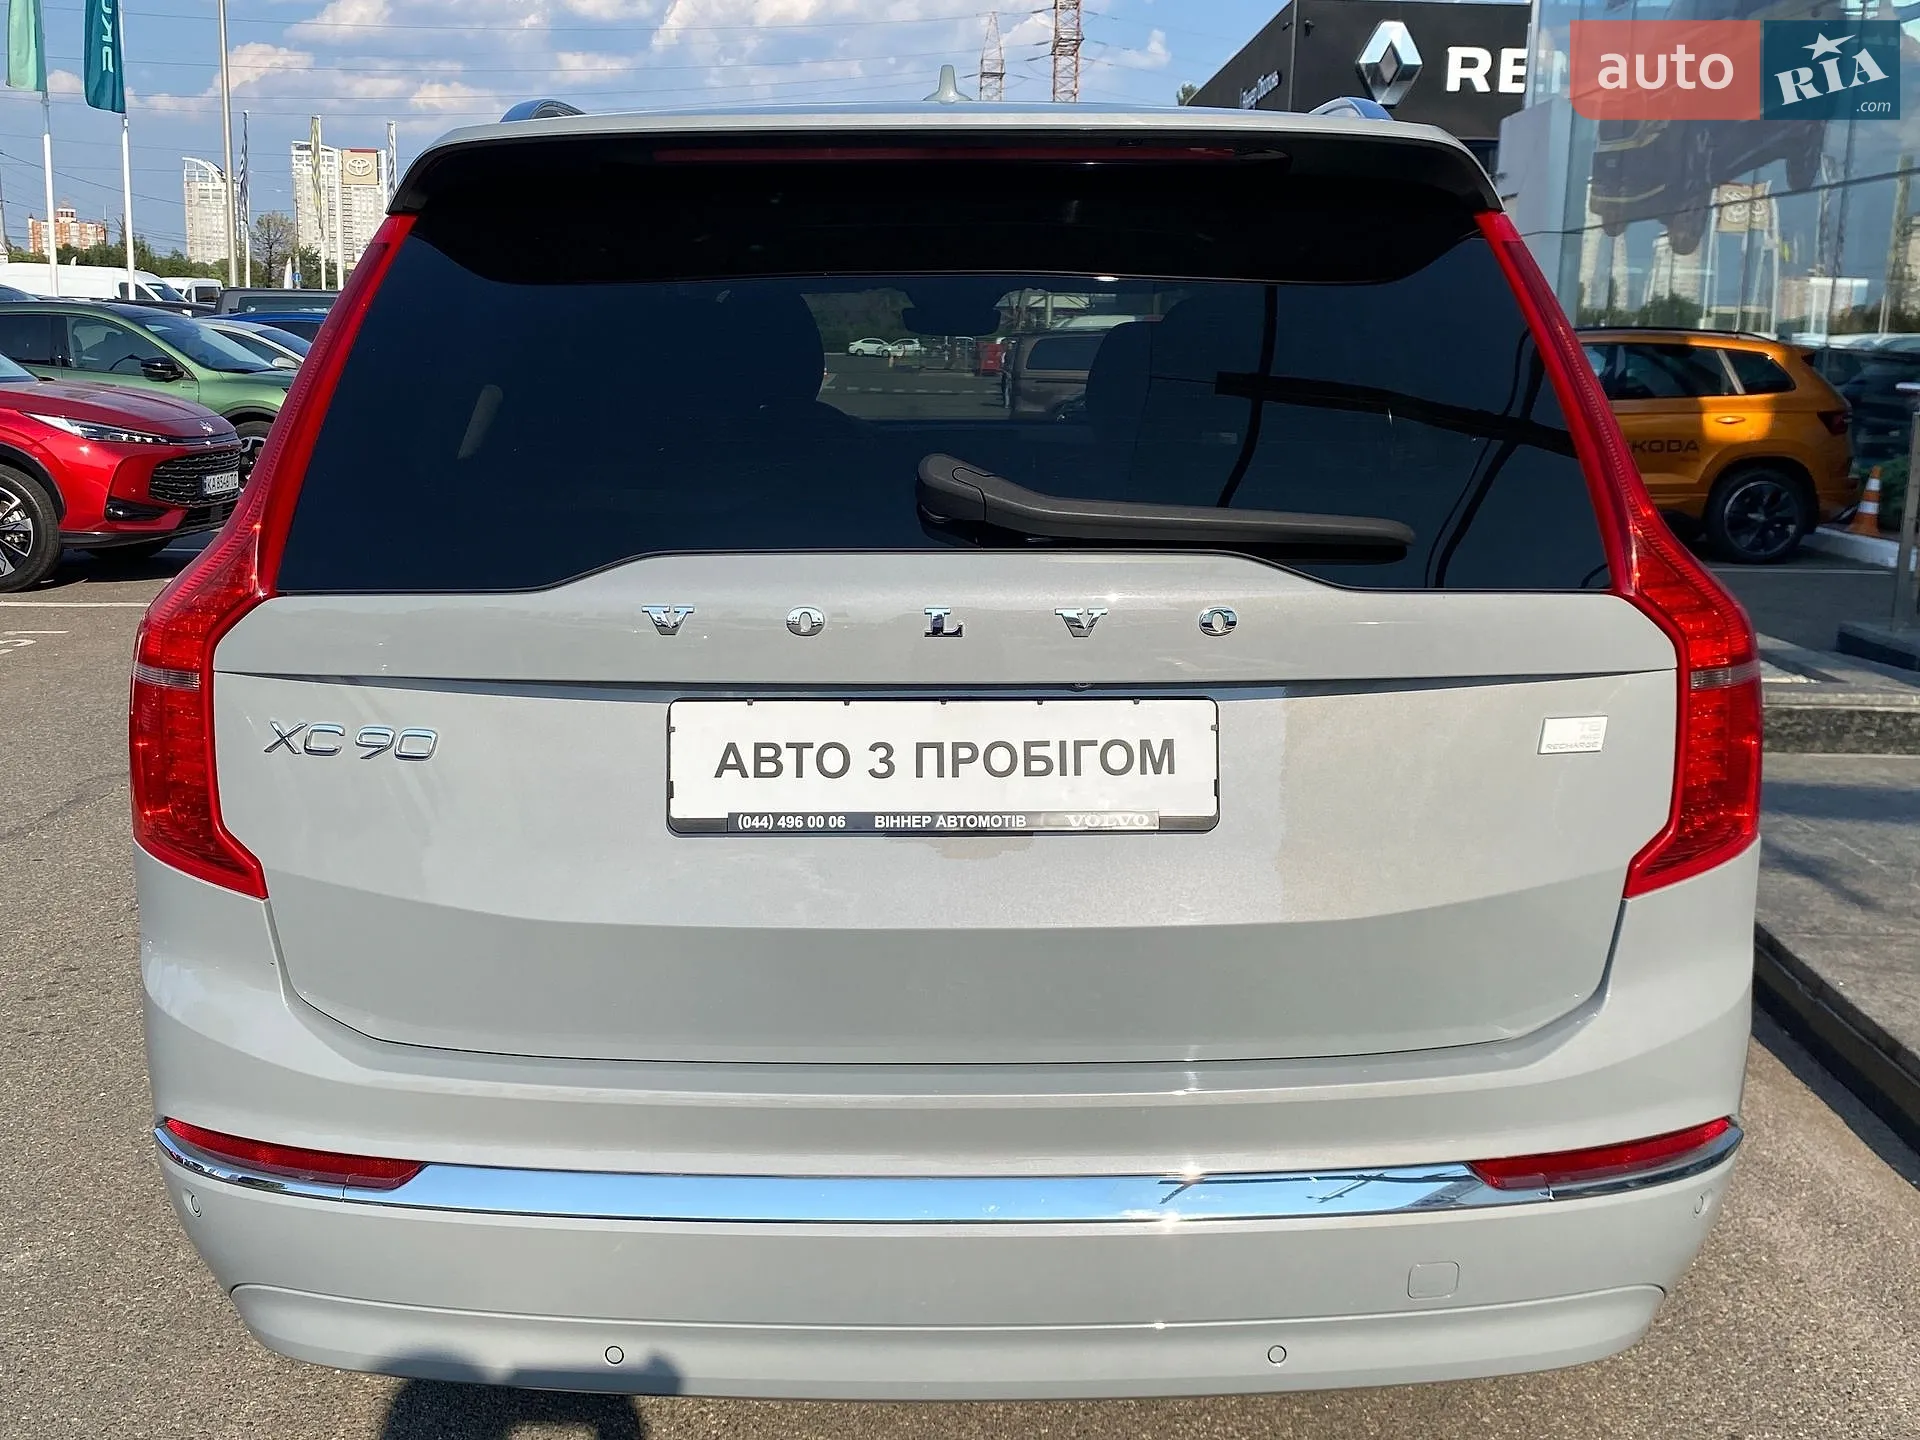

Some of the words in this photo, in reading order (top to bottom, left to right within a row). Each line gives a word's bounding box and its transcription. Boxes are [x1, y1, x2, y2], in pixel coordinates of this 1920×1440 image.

[1446, 46, 1528, 92] RE
[1632, 439, 1698, 453] KODA
[641, 605, 1238, 637] VOLVO
[714, 741, 852, 779] АВТО
[915, 738, 1176, 779] ПРОБІГОМ
[737, 813, 774, 830] (044)
[777, 815, 804, 829] 496
[807, 815, 825, 829] 00
[828, 815, 846, 829] 06
[874, 815, 932, 829] ВІННЕР
[936, 814, 1027, 828] АВТОМОТІВ
[1065, 814, 1150, 827] VOLVO
